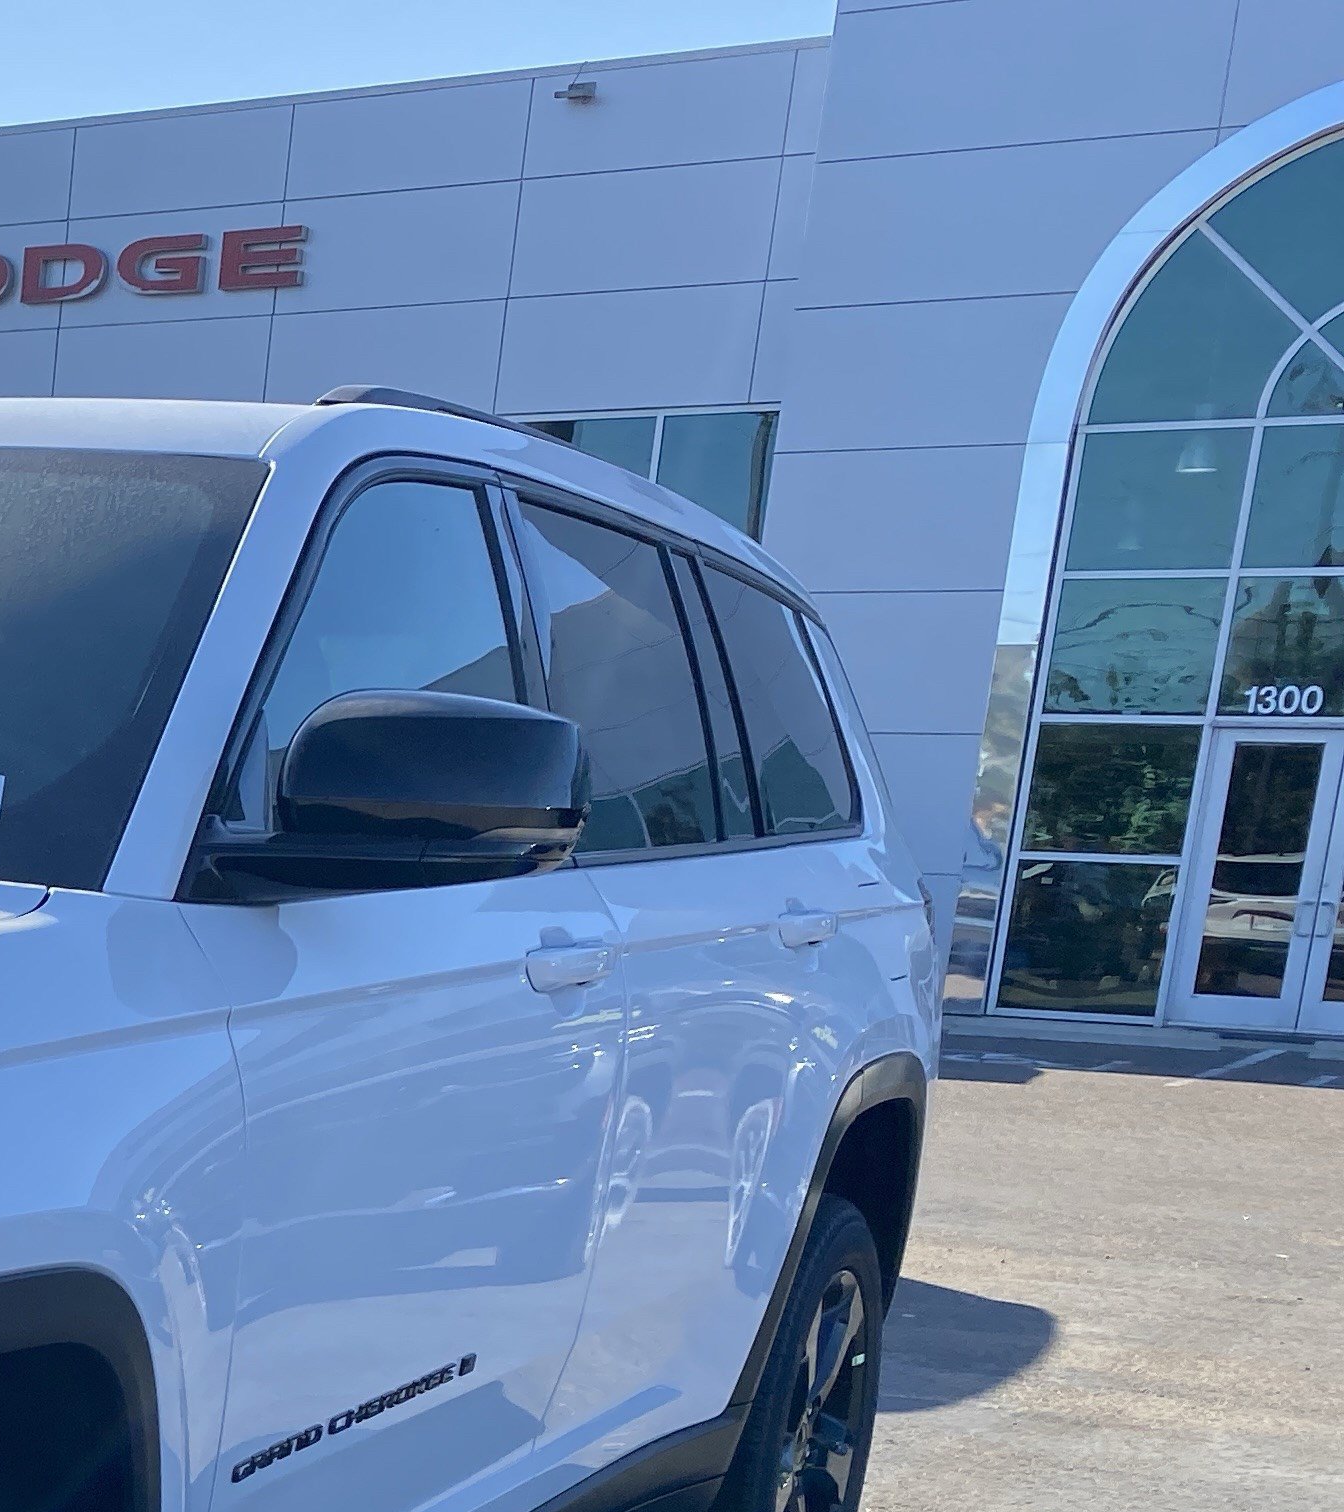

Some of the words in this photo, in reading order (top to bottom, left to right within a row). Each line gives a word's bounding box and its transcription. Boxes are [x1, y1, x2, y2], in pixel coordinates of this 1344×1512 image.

[1243, 685, 1324, 714] 1300
[231, 1423, 324, 1483] GRAND
[327, 1362, 457, 1435] CHEROKEE
